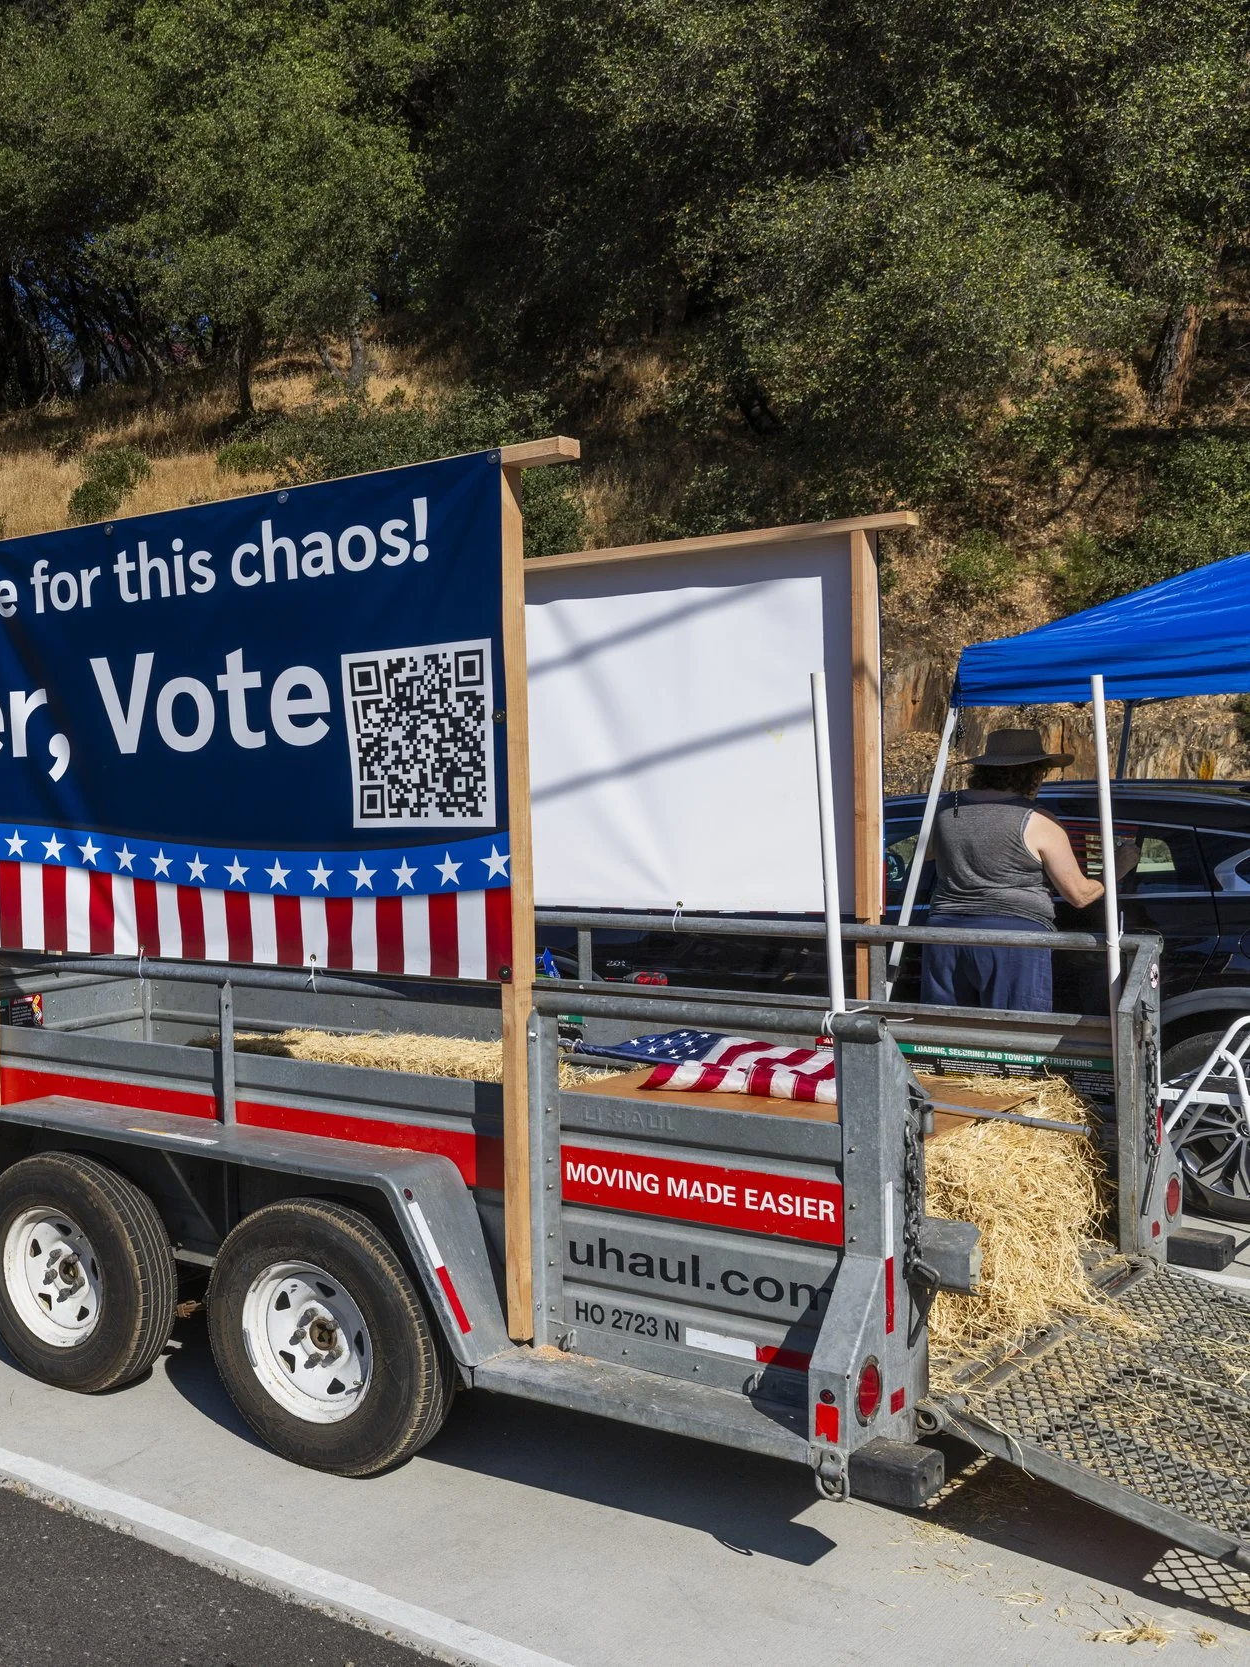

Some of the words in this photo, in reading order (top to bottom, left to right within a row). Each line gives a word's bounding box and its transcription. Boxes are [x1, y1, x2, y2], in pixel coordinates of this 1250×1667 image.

[31, 560, 101, 614] for
[114, 539, 216, 602] this
[231, 497, 430, 587] chaos!
[90, 648, 331, 754] Vote
[914, 1045, 947, 1057] LOADING,
[986, 1052, 1003, 1061] AND
[1004, 1053, 1034, 1064] TOWING
[1036, 1056, 1093, 1068] INSTRUCTIONS
[565, 1161, 660, 1195] MOVING
[667, 1176, 737, 1207] MADE
[744, 1188, 836, 1223] EASIER
[568, 1237, 834, 1311] uhaul.com
[575, 1300, 605, 1324] HO
[611, 1309, 658, 1337] 2723
[665, 1319, 679, 1342] N
